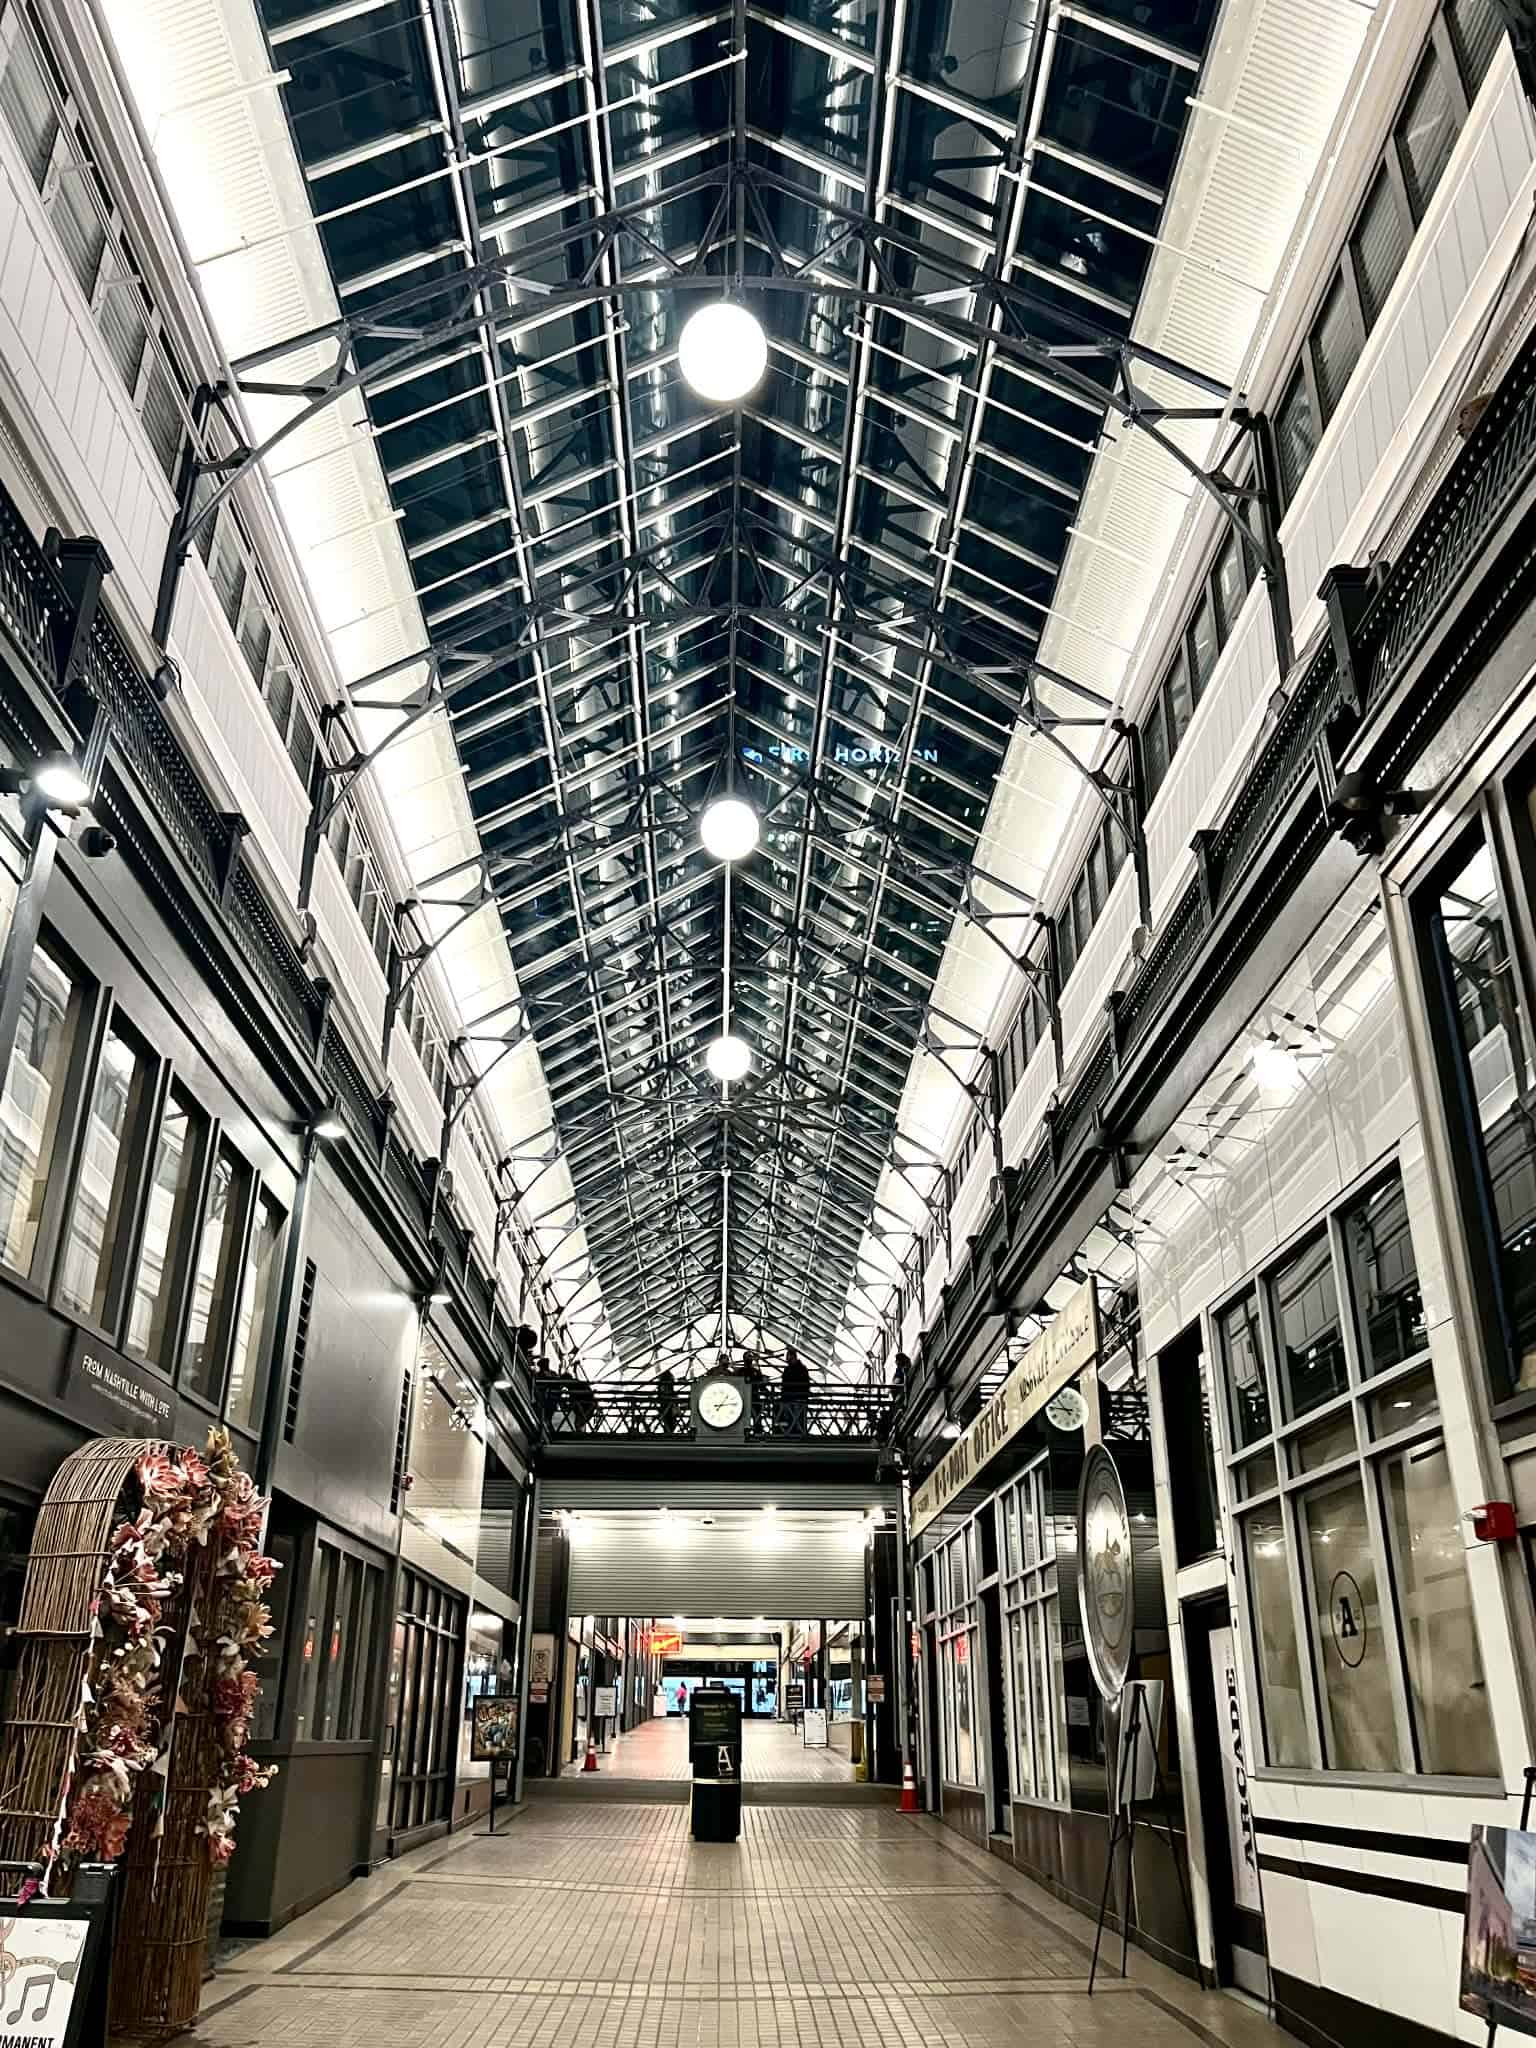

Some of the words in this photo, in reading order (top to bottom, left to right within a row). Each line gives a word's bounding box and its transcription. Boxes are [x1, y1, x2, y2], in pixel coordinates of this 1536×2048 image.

[82, 1354, 104, 1379] FROM
[103, 1367, 139, 1400] NASHVILLE
[138, 1388, 156, 1410] WITH
[154, 1398, 171, 1419] LOVE
[973, 1389, 1009, 1465] OFFICE
[1225, 1667, 1257, 1872] ARCADE
[0, 2034, 55, 2048] MANENT
